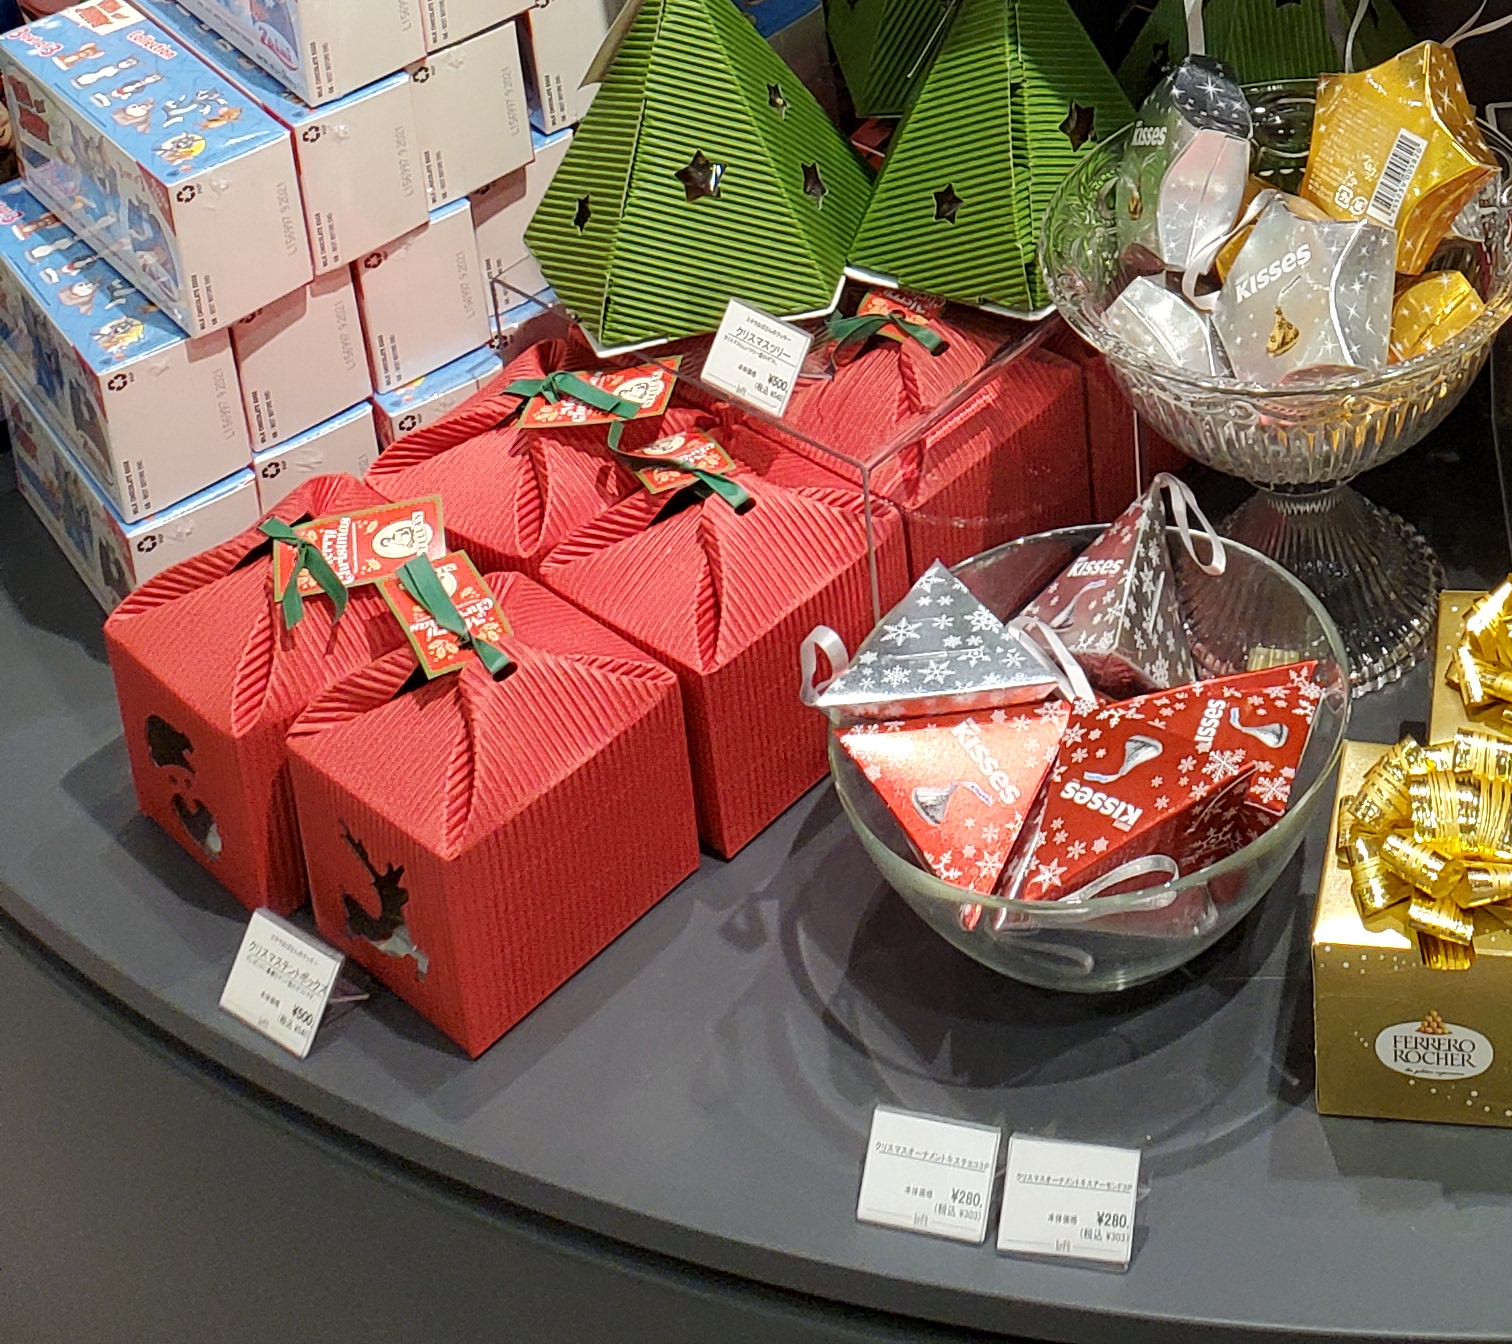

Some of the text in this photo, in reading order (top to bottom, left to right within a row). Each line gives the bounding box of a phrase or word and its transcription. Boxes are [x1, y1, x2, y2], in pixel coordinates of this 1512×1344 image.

[735, 326, 792, 359] クリスマスツリー
[1393, 1034, 1478, 1053] FERRERO
[1391, 1048, 1475, 1067] ROCHER
[951, 1186, 984, 1209] ¥280.
[1096, 1210, 1130, 1230] ¥280.
